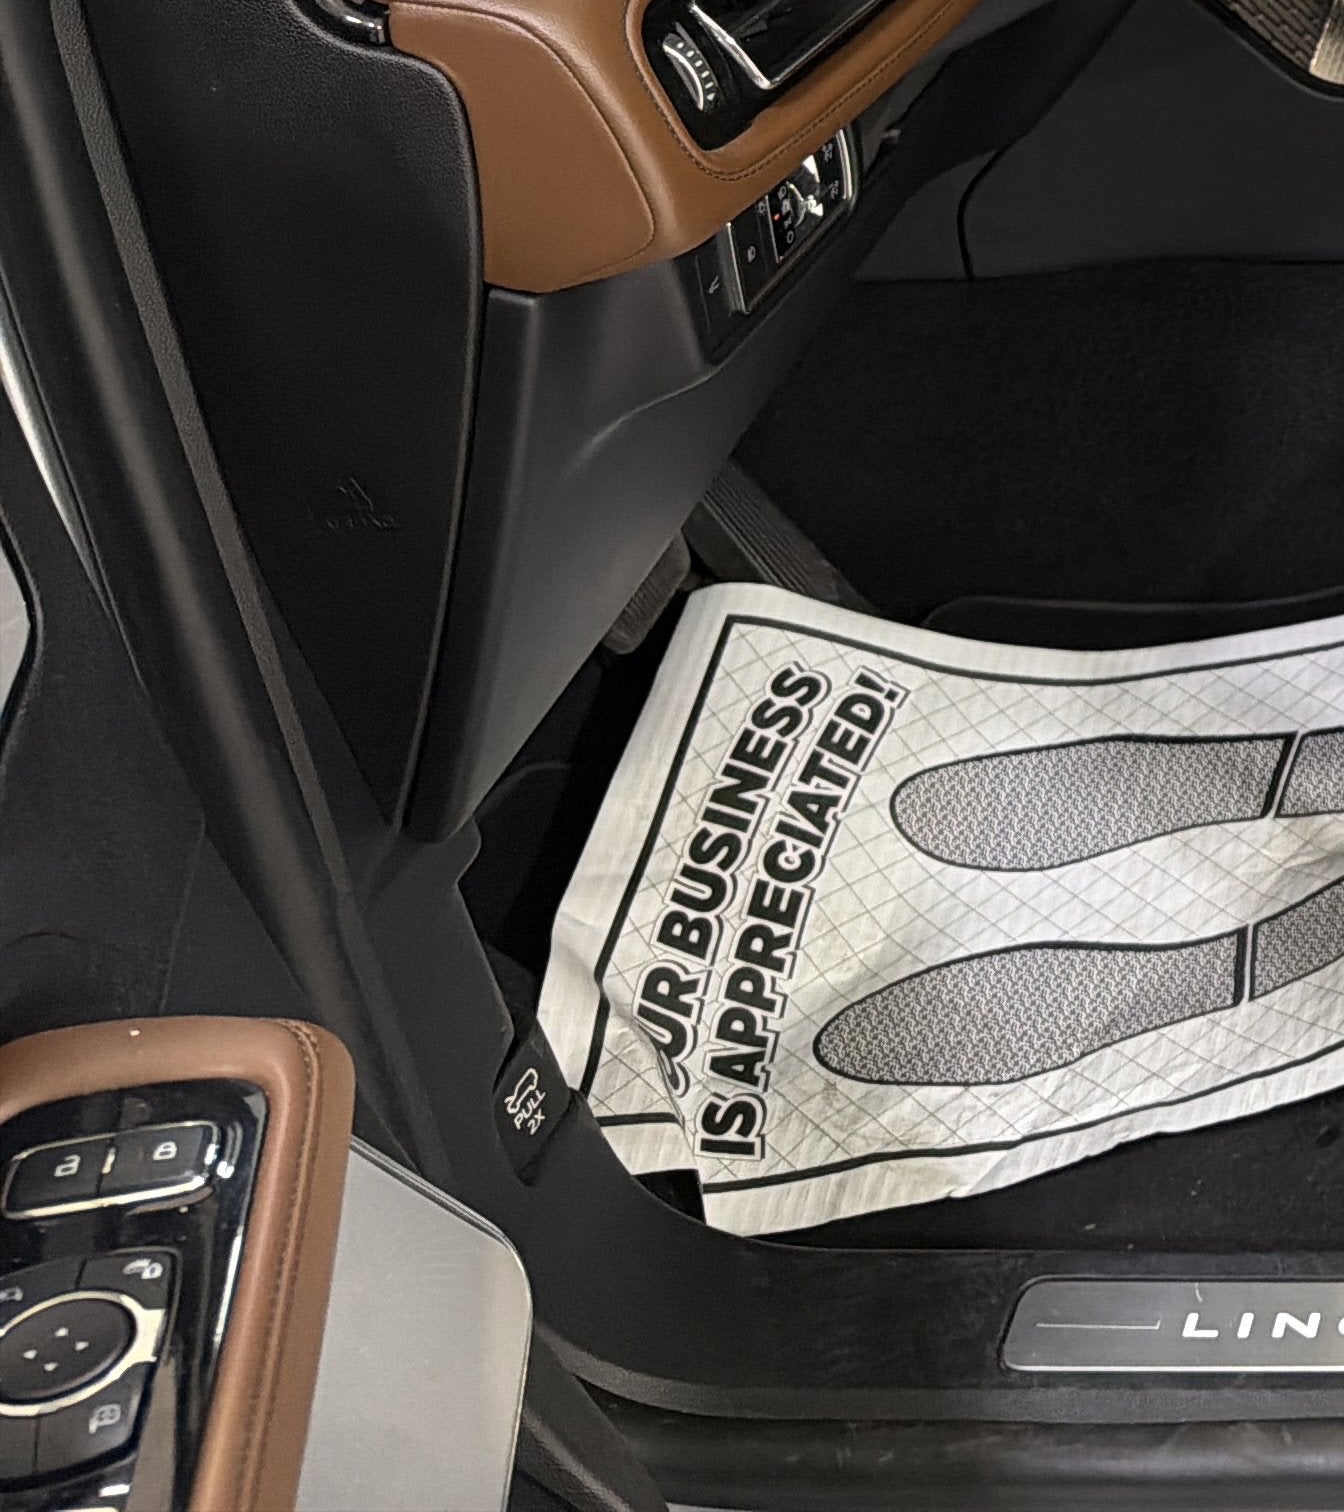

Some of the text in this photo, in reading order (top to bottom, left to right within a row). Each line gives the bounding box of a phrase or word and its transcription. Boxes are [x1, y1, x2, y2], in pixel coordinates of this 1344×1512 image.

[655, 660, 826, 961] BUSINESS
[699, 668, 904, 1158] IS APPRECIATED!
[513, 1090, 547, 1130] PULL
[527, 1108, 546, 1135] 2X
